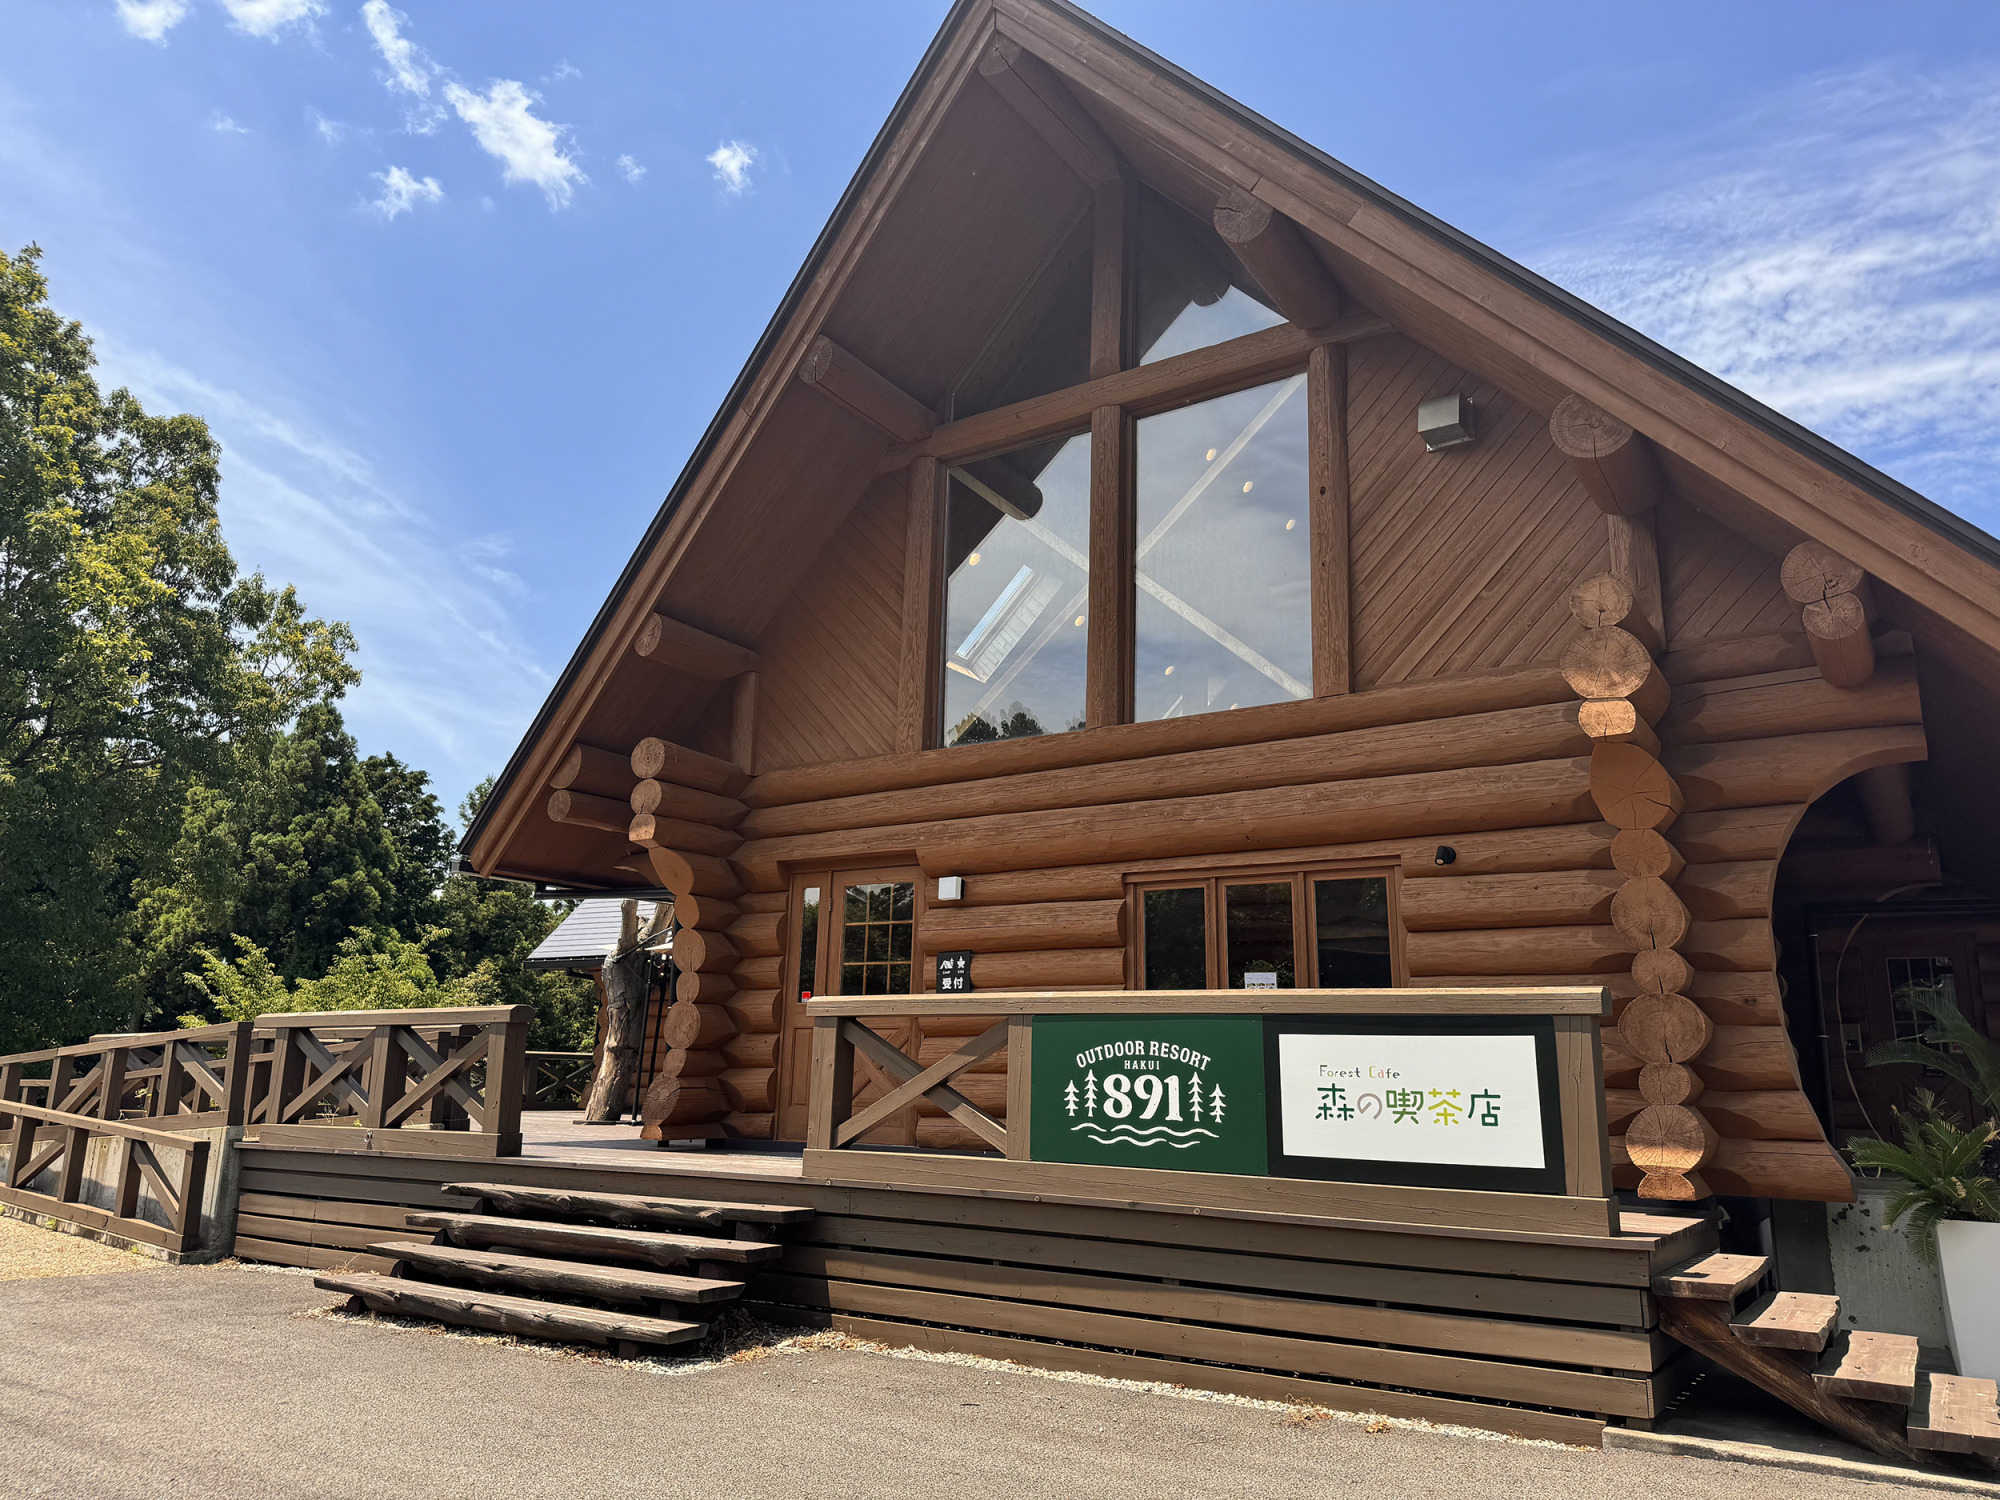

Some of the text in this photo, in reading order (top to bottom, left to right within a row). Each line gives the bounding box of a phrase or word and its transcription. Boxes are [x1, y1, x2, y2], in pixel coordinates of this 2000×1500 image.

[942, 976, 964, 990] 受付
[1076, 1040, 1212, 1071] OUTDOOR RESORT
[1124, 1059, 1160, 1070] HAKUI
[1319, 1065, 1401, 1079] Forest Cafe
[1103, 1074, 1184, 1122] 891
[1315, 1083, 1502, 1127] 森の喫茶店
